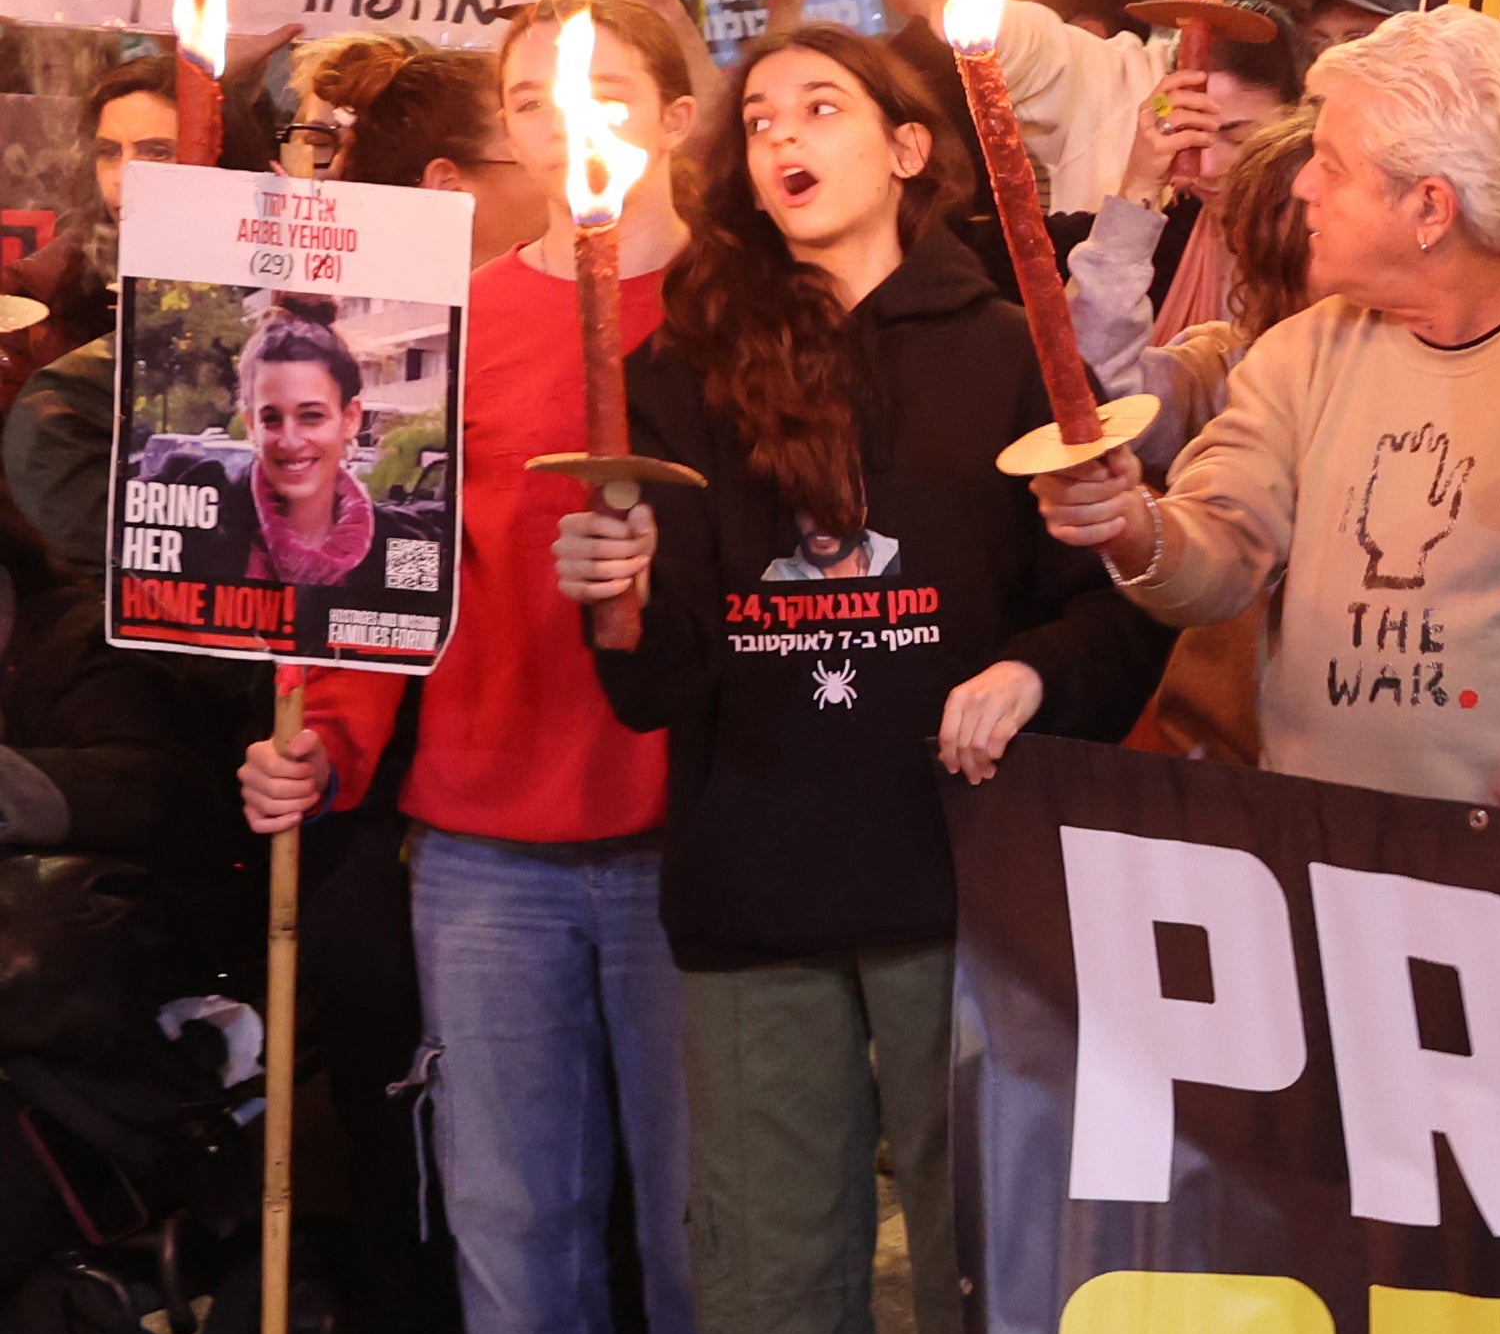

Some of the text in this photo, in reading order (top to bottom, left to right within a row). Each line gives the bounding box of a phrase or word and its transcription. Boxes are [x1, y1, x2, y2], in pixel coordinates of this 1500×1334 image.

[292, 193, 337, 223] ארבל
[237, 219, 357, 253] ARBEL YEHOUD
[248, 250, 295, 280] (29)
[125, 480, 219, 531] BRING
[122, 527, 182, 573] HER
[121, 578, 296, 633] HOME NOW!
[889, 587, 938, 623] מתן
[328, 624, 439, 653] FAMILIES FORUM
[727, 626, 939, 654] נחטף ב-7 לאוקטובר
[1346, 601, 1445, 654] THE
